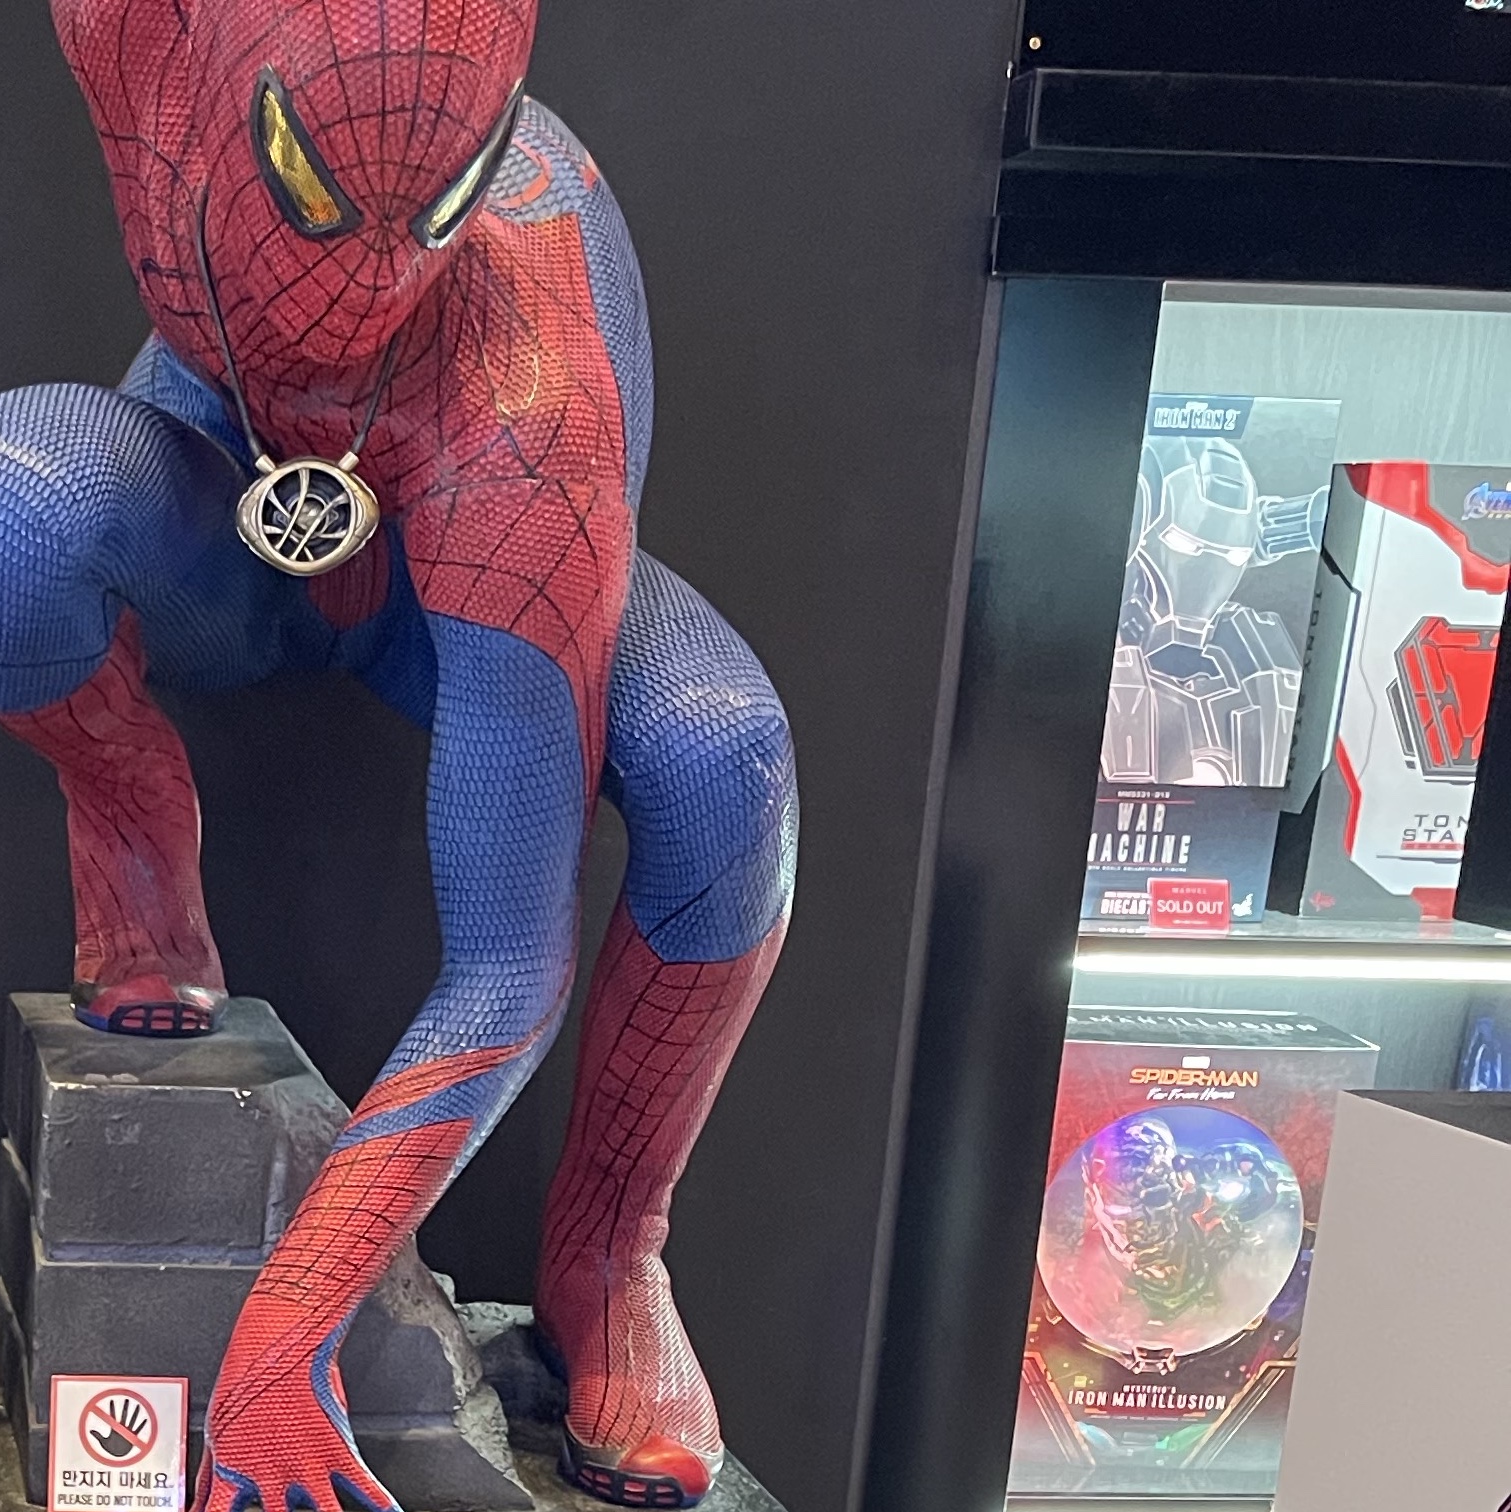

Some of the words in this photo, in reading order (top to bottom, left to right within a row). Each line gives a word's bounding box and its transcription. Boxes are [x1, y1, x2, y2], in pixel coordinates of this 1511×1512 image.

[1118, 803, 1165, 832] WAR
[1157, 900, 1193, 914] SOLD
[1196, 901, 1224, 915] OUT
[1129, 1068, 1258, 1087] SPIDER-MAN
[1068, 1390, 1107, 1406] IRON
[1112, 1392, 1148, 1407] MAN
[1151, 1393, 1226, 1410] ILLUSION
[62, 1470, 111, 1489] 만지지
[58, 1493, 93, 1505] PLEASE
[96, 1495, 110, 1506] DO
[113, 1495, 133, 1506] NOT
